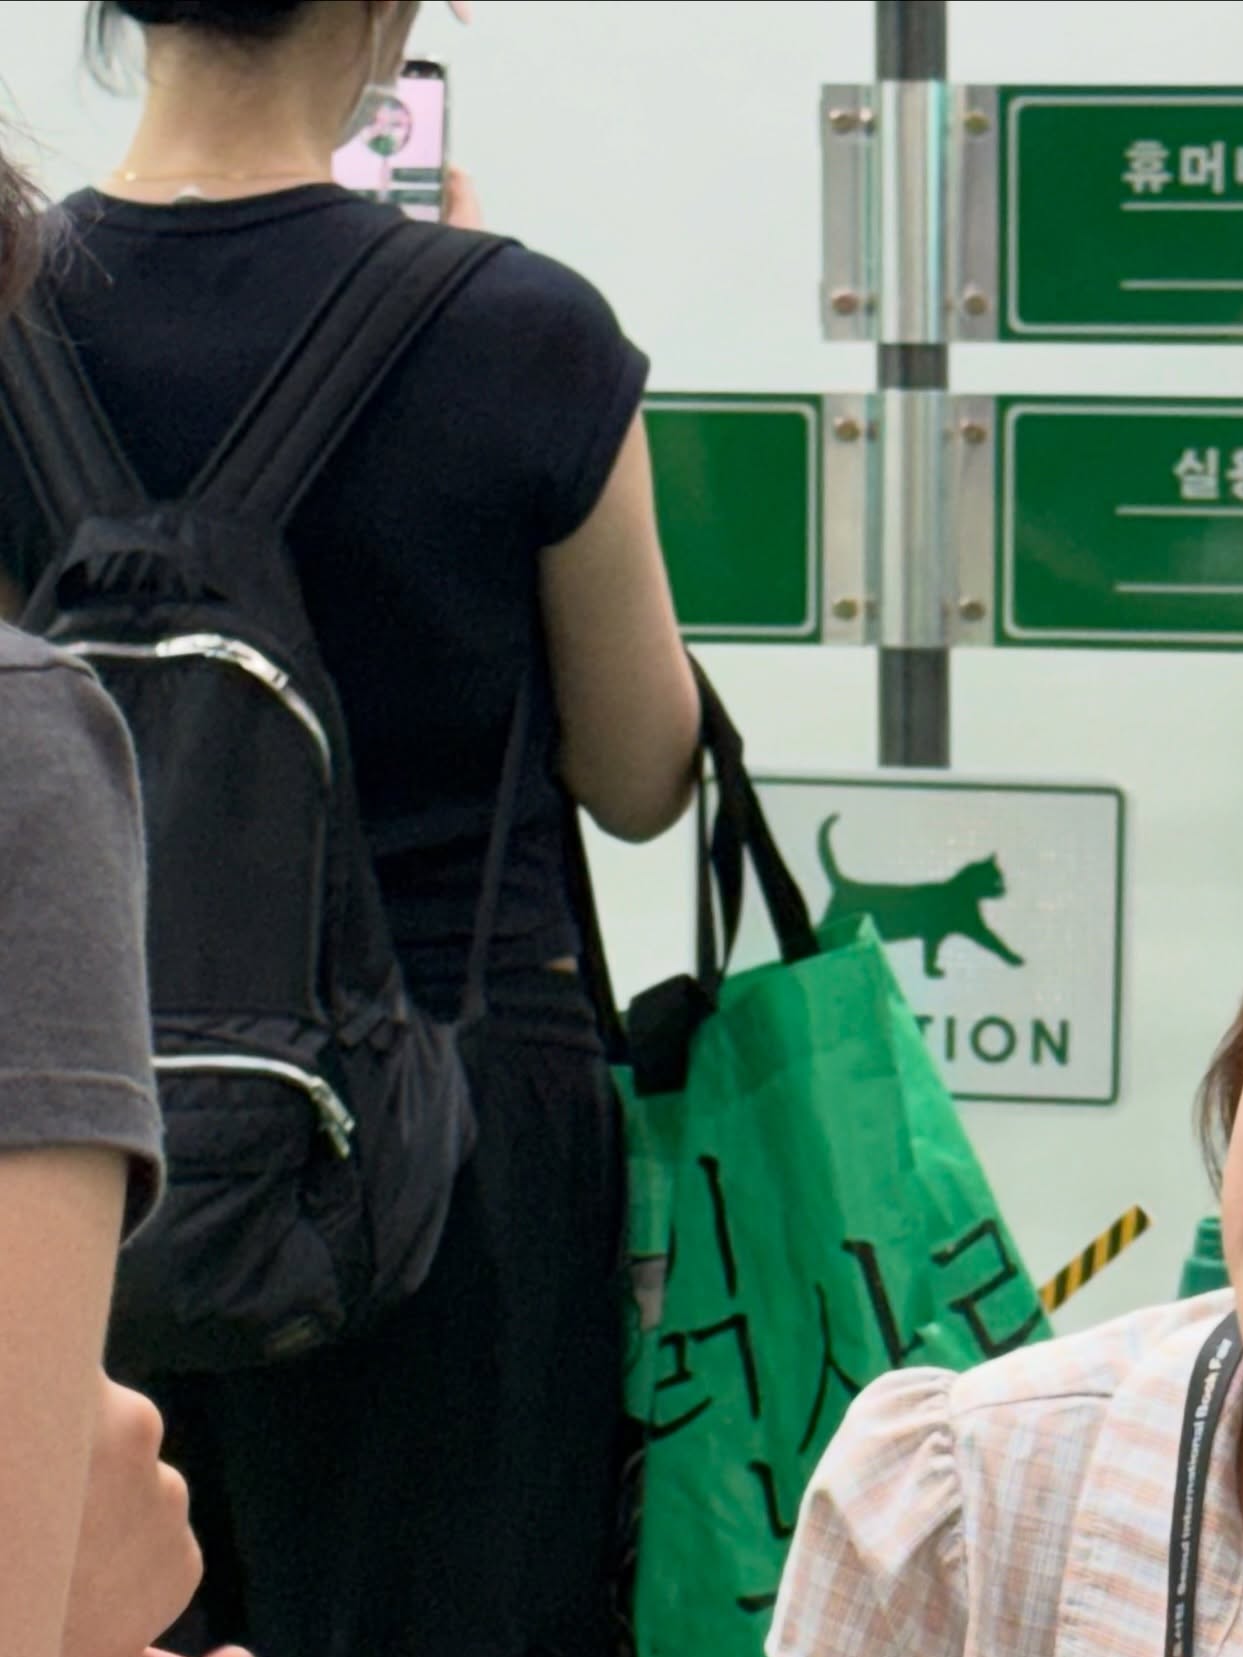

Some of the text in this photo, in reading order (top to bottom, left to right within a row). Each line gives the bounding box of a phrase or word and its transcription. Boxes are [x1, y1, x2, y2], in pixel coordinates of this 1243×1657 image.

[1194, 1368, 1222, 1419] Book
[1181, 1420, 1206, 1540] International
[1176, 1540, 1190, 1597] Seoul
